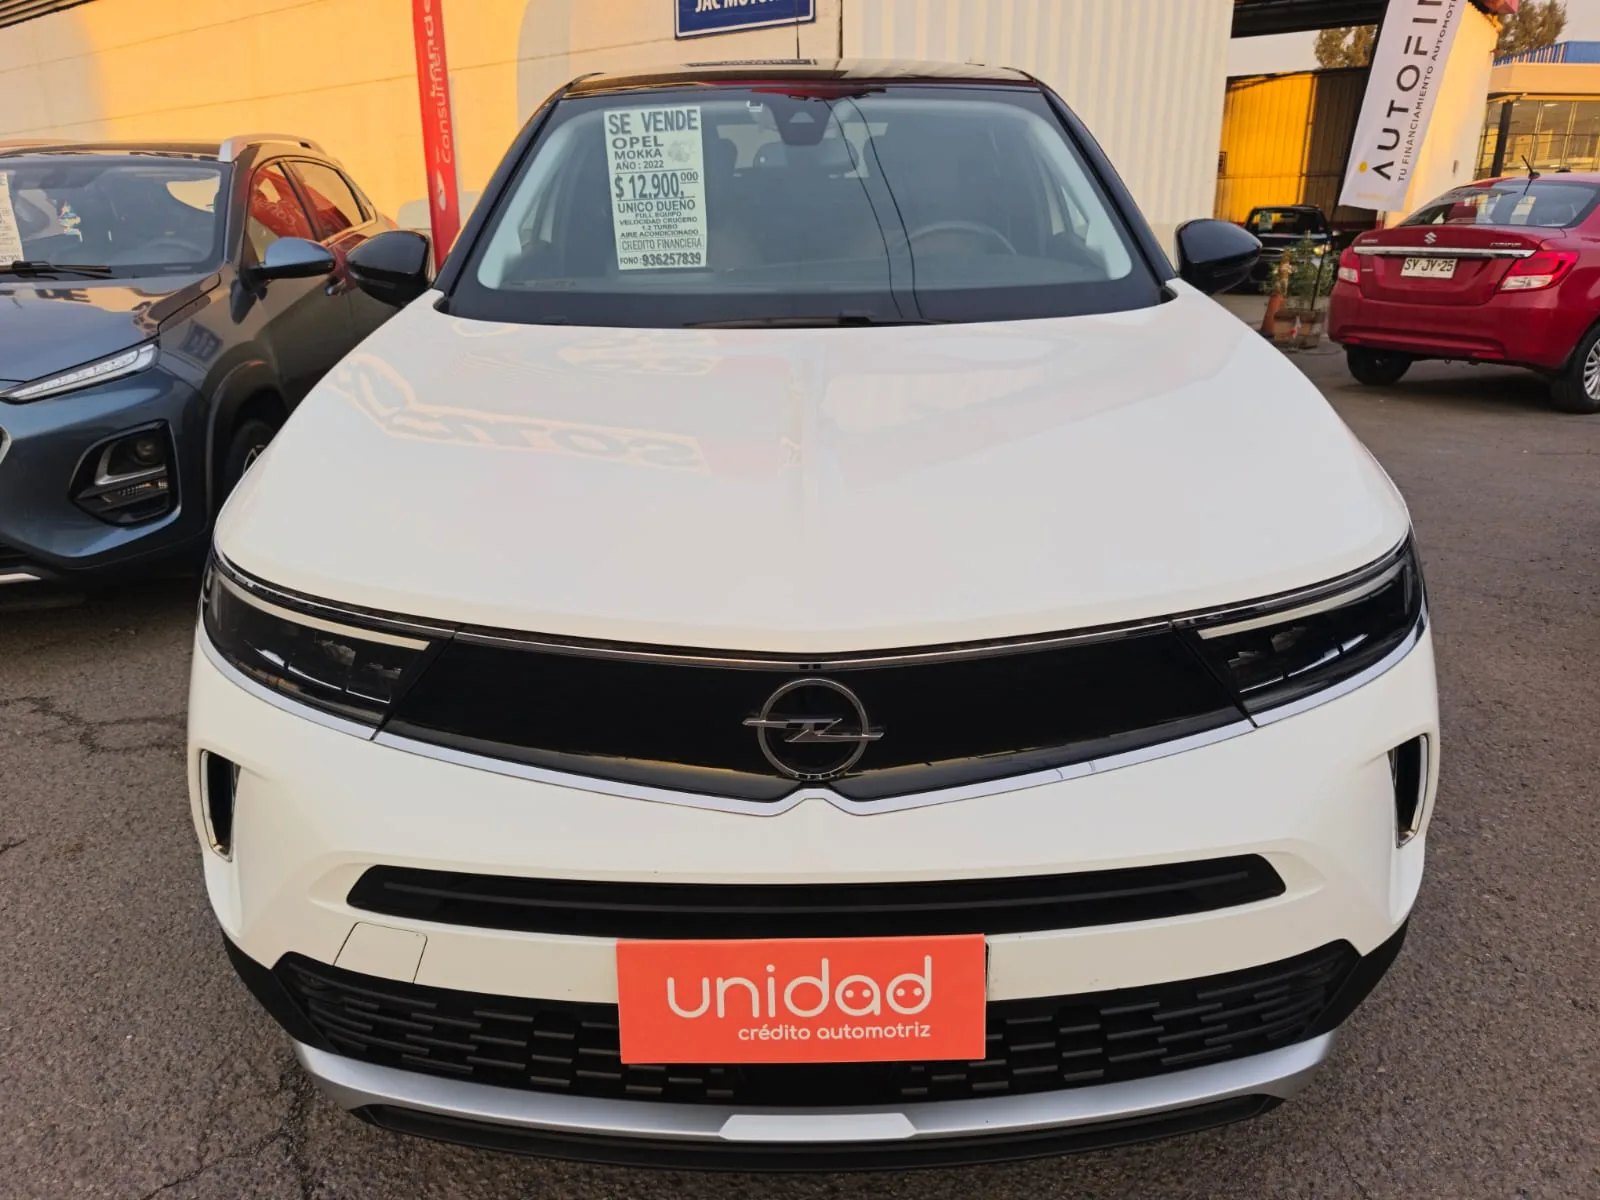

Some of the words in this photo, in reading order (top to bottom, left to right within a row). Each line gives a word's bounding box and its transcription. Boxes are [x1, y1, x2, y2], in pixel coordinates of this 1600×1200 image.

[1431, 0, 1457, 62] AUTOMOT
[608, 113, 632, 135] SE
[640, 109, 699, 132] VENDE
[1402, 66, 1433, 165] FINANCIAMIENTO
[612, 135, 664, 149] OPEL
[614, 148, 663, 160] MOKKA
[643, 160, 665, 169] 2022
[680, 171, 699, 182] 000
[1398, 168, 1408, 182] TU
[617, 201, 654, 213] UNICO
[640, 229, 699, 237] ACONDICIONADO
[657, 237, 702, 249] FINANCIERA
[667, 955, 932, 1018] unidad
[738, 1023, 810, 1040] crédito
[816, 1021, 931, 1039] automotriz
